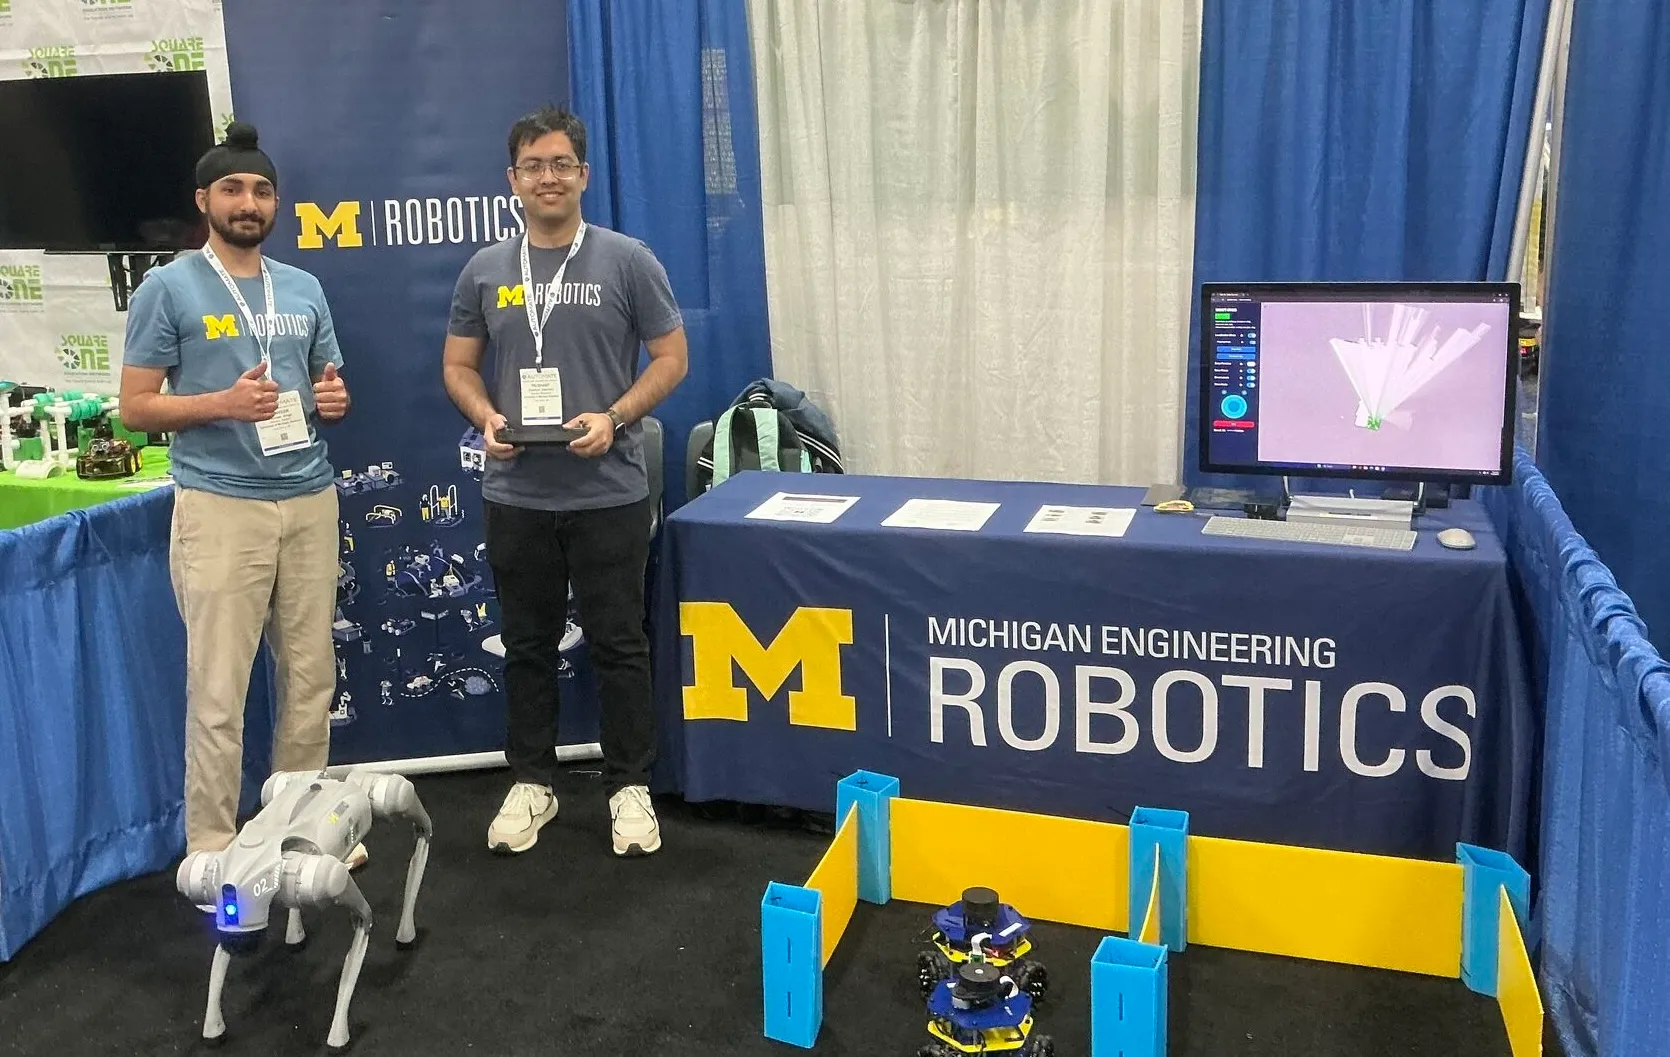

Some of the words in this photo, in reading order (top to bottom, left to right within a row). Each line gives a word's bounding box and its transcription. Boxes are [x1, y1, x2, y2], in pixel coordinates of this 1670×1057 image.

[295, 201, 362, 249] M
[384, 195, 525, 246] ROBOTICS
[0, 264, 40, 277] QUARE
[497, 284, 525, 309] M
[61, 335, 108, 347] SQUARE
[202, 313, 240, 340] M
[249, 312, 309, 338] OOTICS
[928, 616, 1091, 653] MICHIGAN
[1101, 625, 1337, 669] ENGINEERING
[679, 601, 857, 731] M
[929, 656, 1476, 781] ROBOTICS
